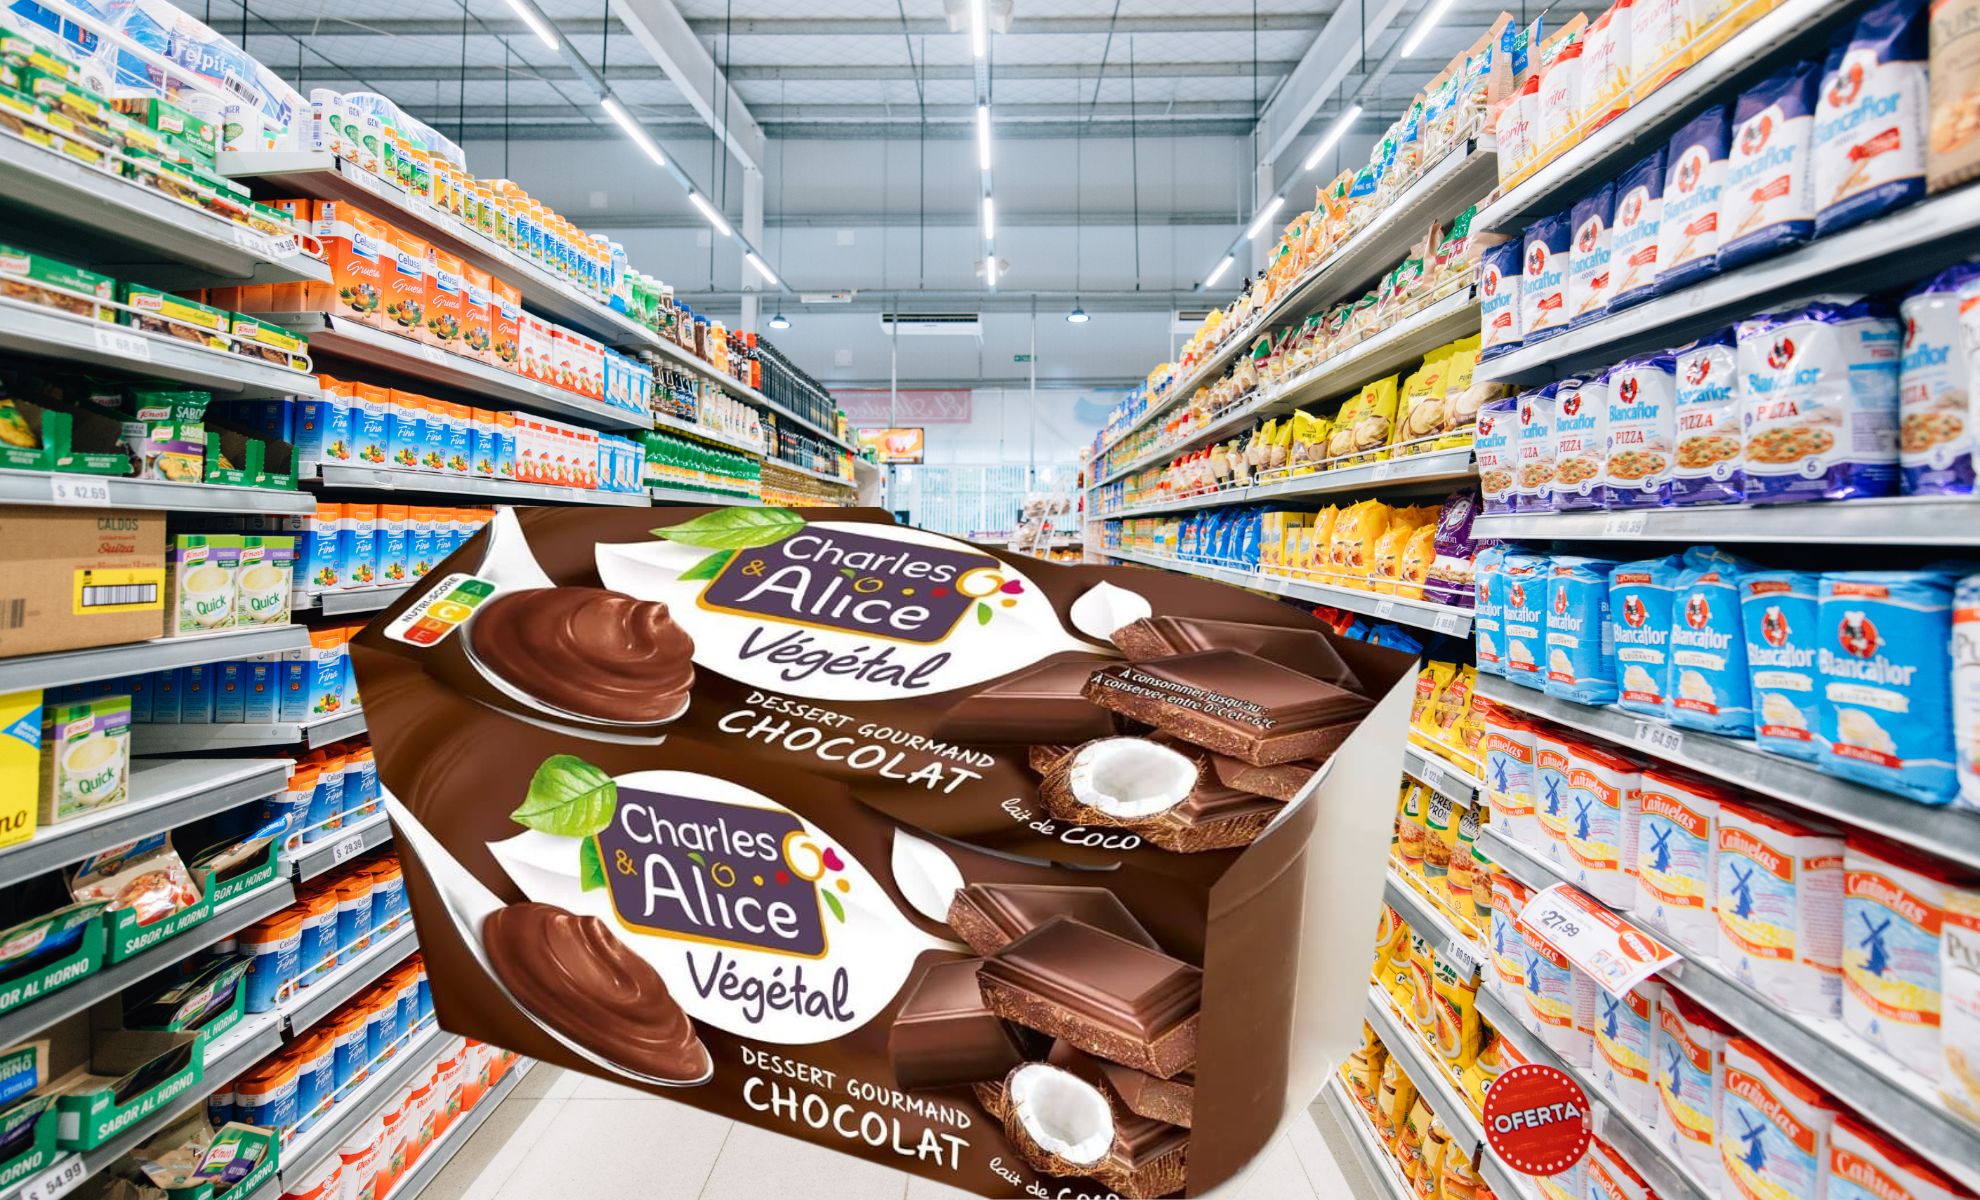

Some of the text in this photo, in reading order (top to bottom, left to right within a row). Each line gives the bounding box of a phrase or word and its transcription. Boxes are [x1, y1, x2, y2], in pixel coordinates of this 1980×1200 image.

[1609, 402, 1660, 422] Blancaflor
[1680, 414, 1713, 430] PIZZA
[1560, 440, 1581, 452] PIZZA
[1616, 430, 1643, 445] PIZZA
[1717, 465, 1726, 476] 6
[97, 517, 139, 531] CALDOS
[782, 534, 957, 583] Charles
[197, 595, 226, 615] Quick
[252, 592, 280, 610] Quick
[401, 576, 460, 622] NUTRI-SCORE
[438, 605, 461, 618] C
[734, 558, 931, 632] & Alice
[1613, 623, 1668, 645] Blancaflor
[1672, 624, 1733, 649] Blancaflor
[738, 626, 952, 690] Végétal
[1104, 677, 1165, 699] conserver
[1167, 695, 1201, 710] entre
[746, 690, 996, 769] DESSERT GOURMAND
[1639, 725, 1680, 751] $ 64.99
[718, 709, 983, 796] CHOCOLAT
[79, 767, 115, 794] Quick
[1568, 770, 1609, 802] Cañuelas
[1001, 798, 1029, 824] lait
[1030, 818, 1054, 837] de
[1642, 793, 1697, 831] Cañuelas
[620, 803, 778, 862] Charles
[1719, 830, 1780, 872] Cañuelas
[244, 866, 273, 889] HORNO
[615, 848, 799, 939] & Alice
[1848, 875, 1929, 924] Cañuelas
[125, 905, 209, 954] SABOR AL HORNO
[0, 958, 89, 1010] OR AL HORNO
[686, 951, 856, 1024] Végétal
[213, 1009, 239, 1036] HORNO
[98, 1072, 194, 1140] SABOR AL HORNO
[740, 1046, 972, 1130] DESSERT GOURMAND
[1728, 1071, 1800, 1141] Cañuelas
[742, 1076, 972, 1172] CHOCOLAT
[1494, 1101, 1582, 1136] OFERTA
[46, 1163, 82, 1194] 54.99
[246, 1160, 274, 1192] HORNO
[989, 1157, 1022, 1187] lait
[1026, 1180, 1050, 1200] de
